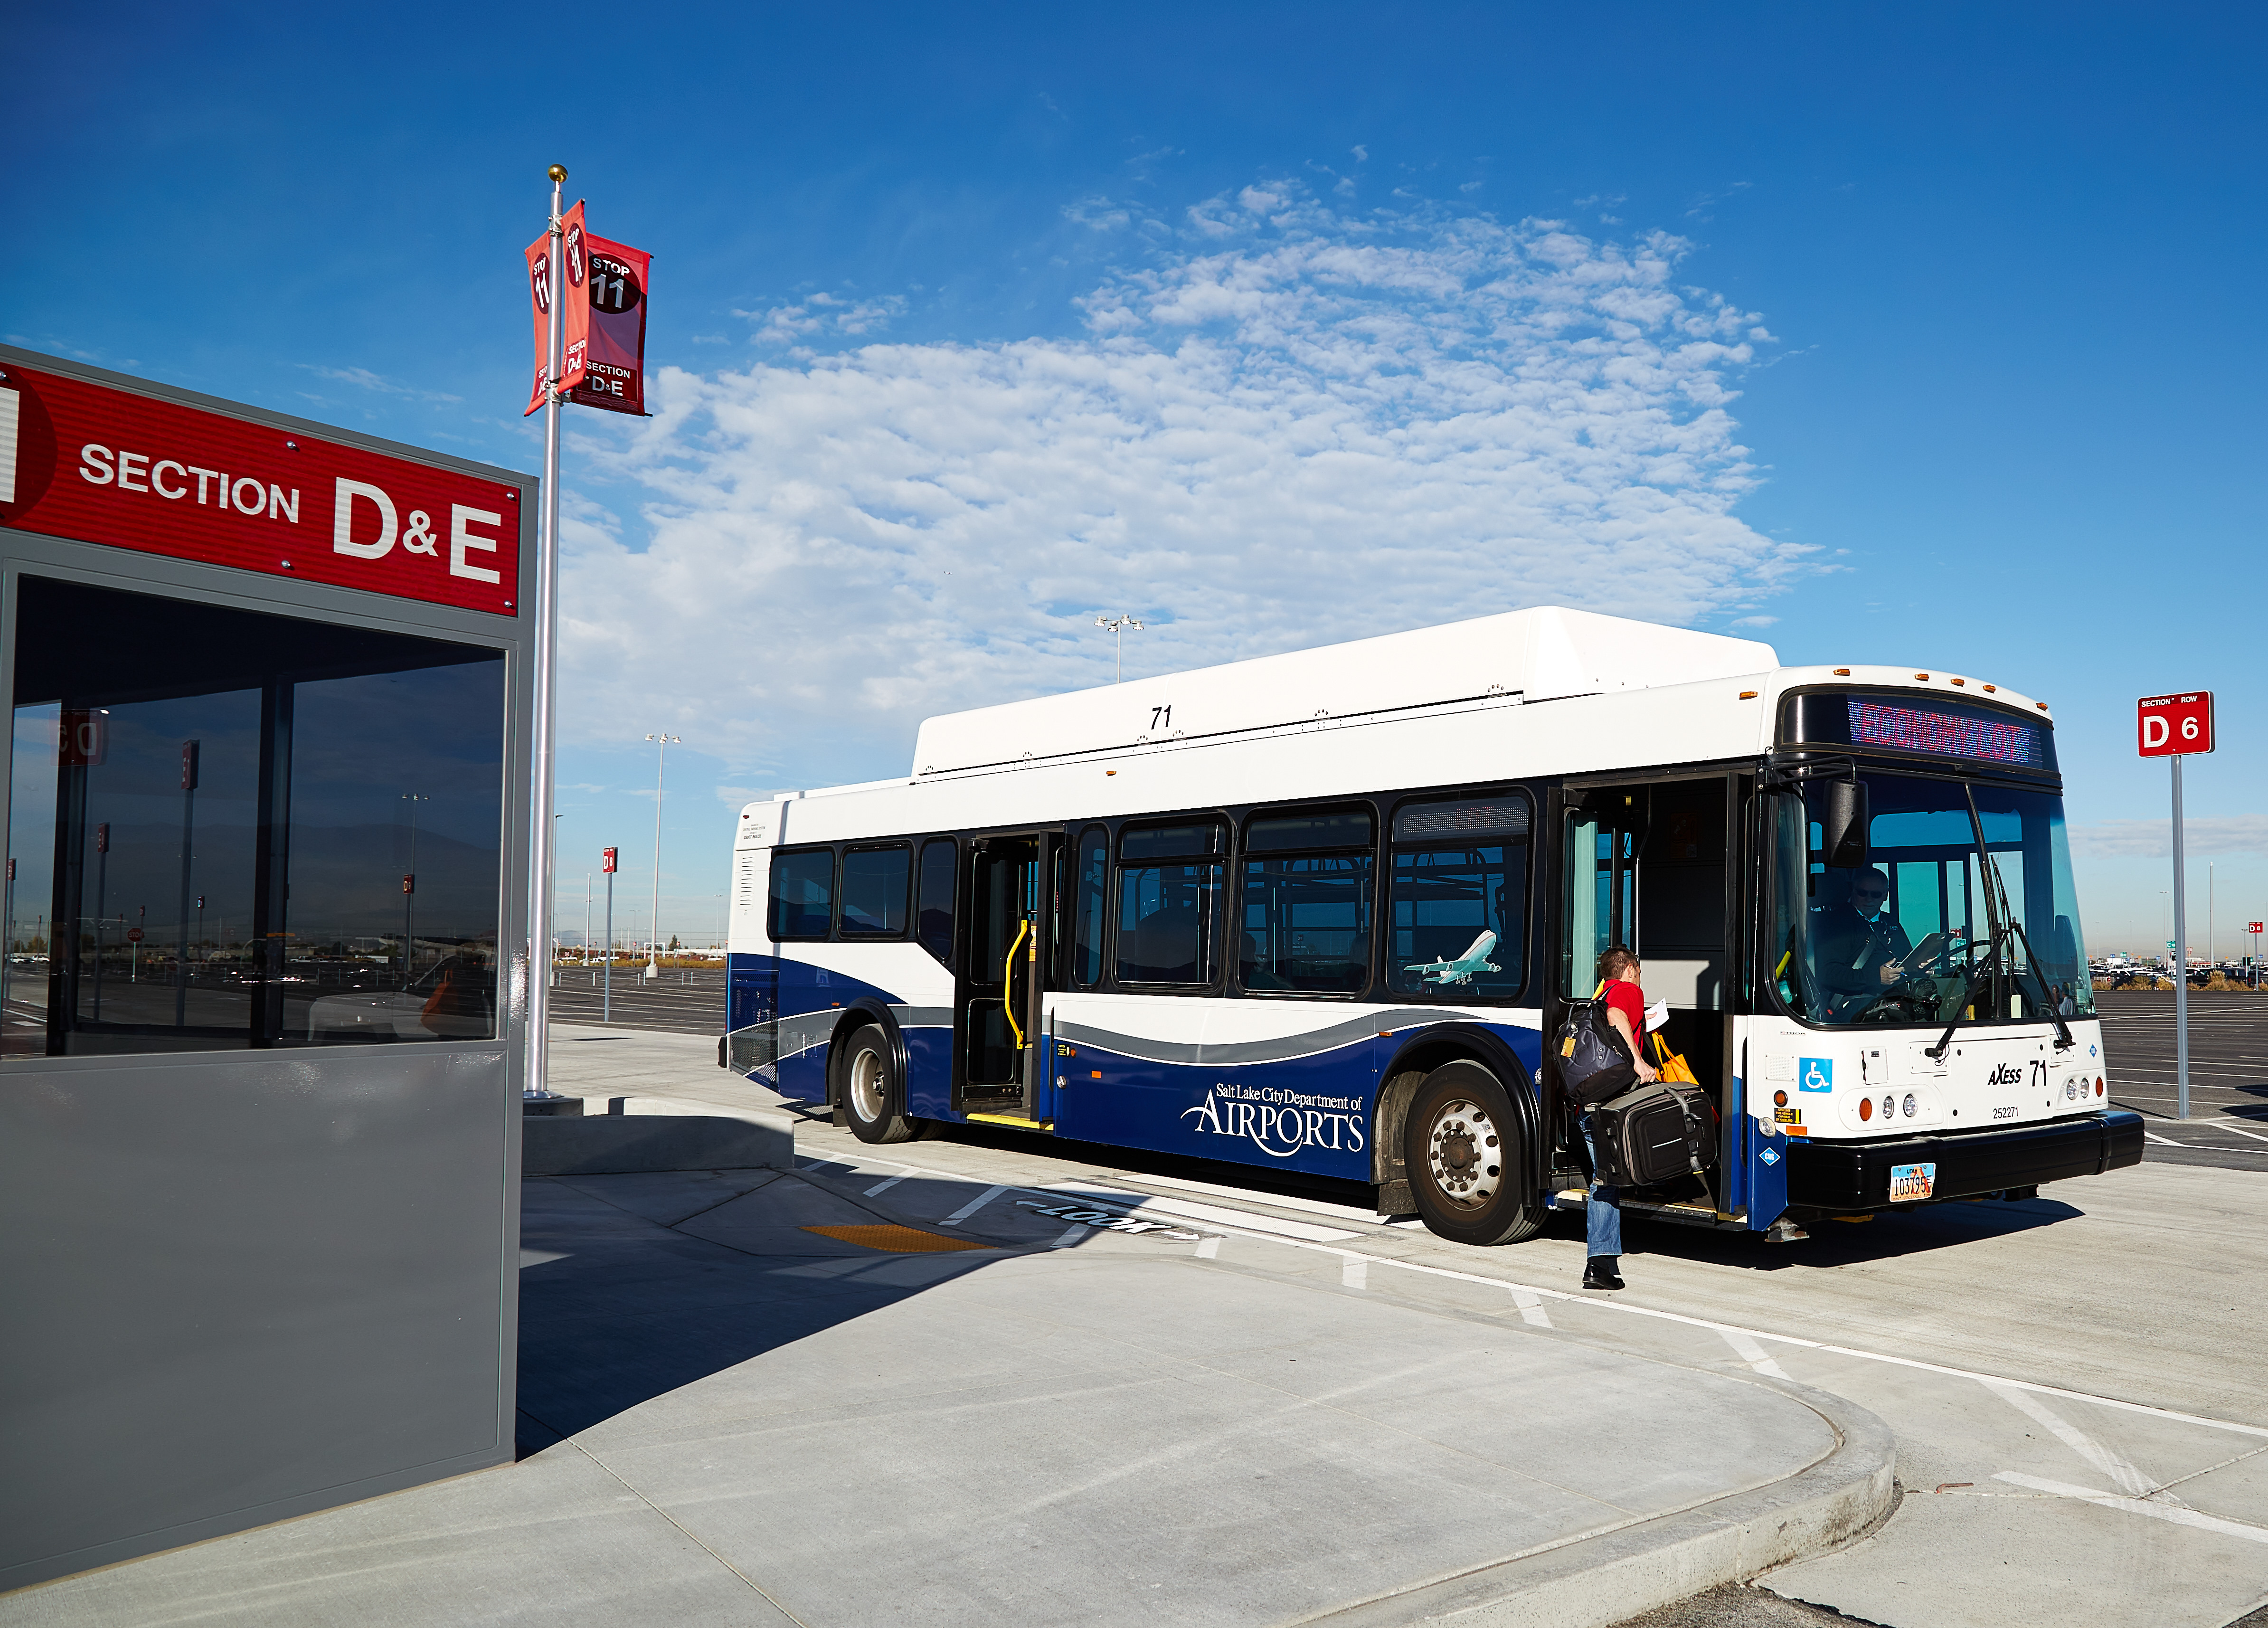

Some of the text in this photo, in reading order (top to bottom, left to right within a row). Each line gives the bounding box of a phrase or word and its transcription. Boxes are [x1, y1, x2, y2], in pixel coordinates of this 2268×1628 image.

[593, 258, 630, 276] STOP
[536, 272, 549, 308] 11
[591, 274, 624, 308] 11
[586, 361, 631, 379] SECTION
[592, 375, 623, 396] D&E
[79, 444, 501, 584] SECTION D&E
[2141, 699, 2171, 707] SECTION
[1151, 705, 1171, 729] 71
[1861, 703, 2020, 761] ECONOMY LOT
[2143, 715, 2199, 748] D 6
[604, 855, 613, 870] D 8
[2030, 1060, 2047, 1087] 71
[1216, 1083, 1363, 1111] Salt Lake City Department of
[1181, 1089, 1363, 1157] AIRPORTS
[1993, 1106, 2019, 1119] 252271
[1765, 1152, 1775, 1160] CNG
[1895, 1175, 1926, 1196] 103795
[1036, 1205, 1172, 1233] LOOK
